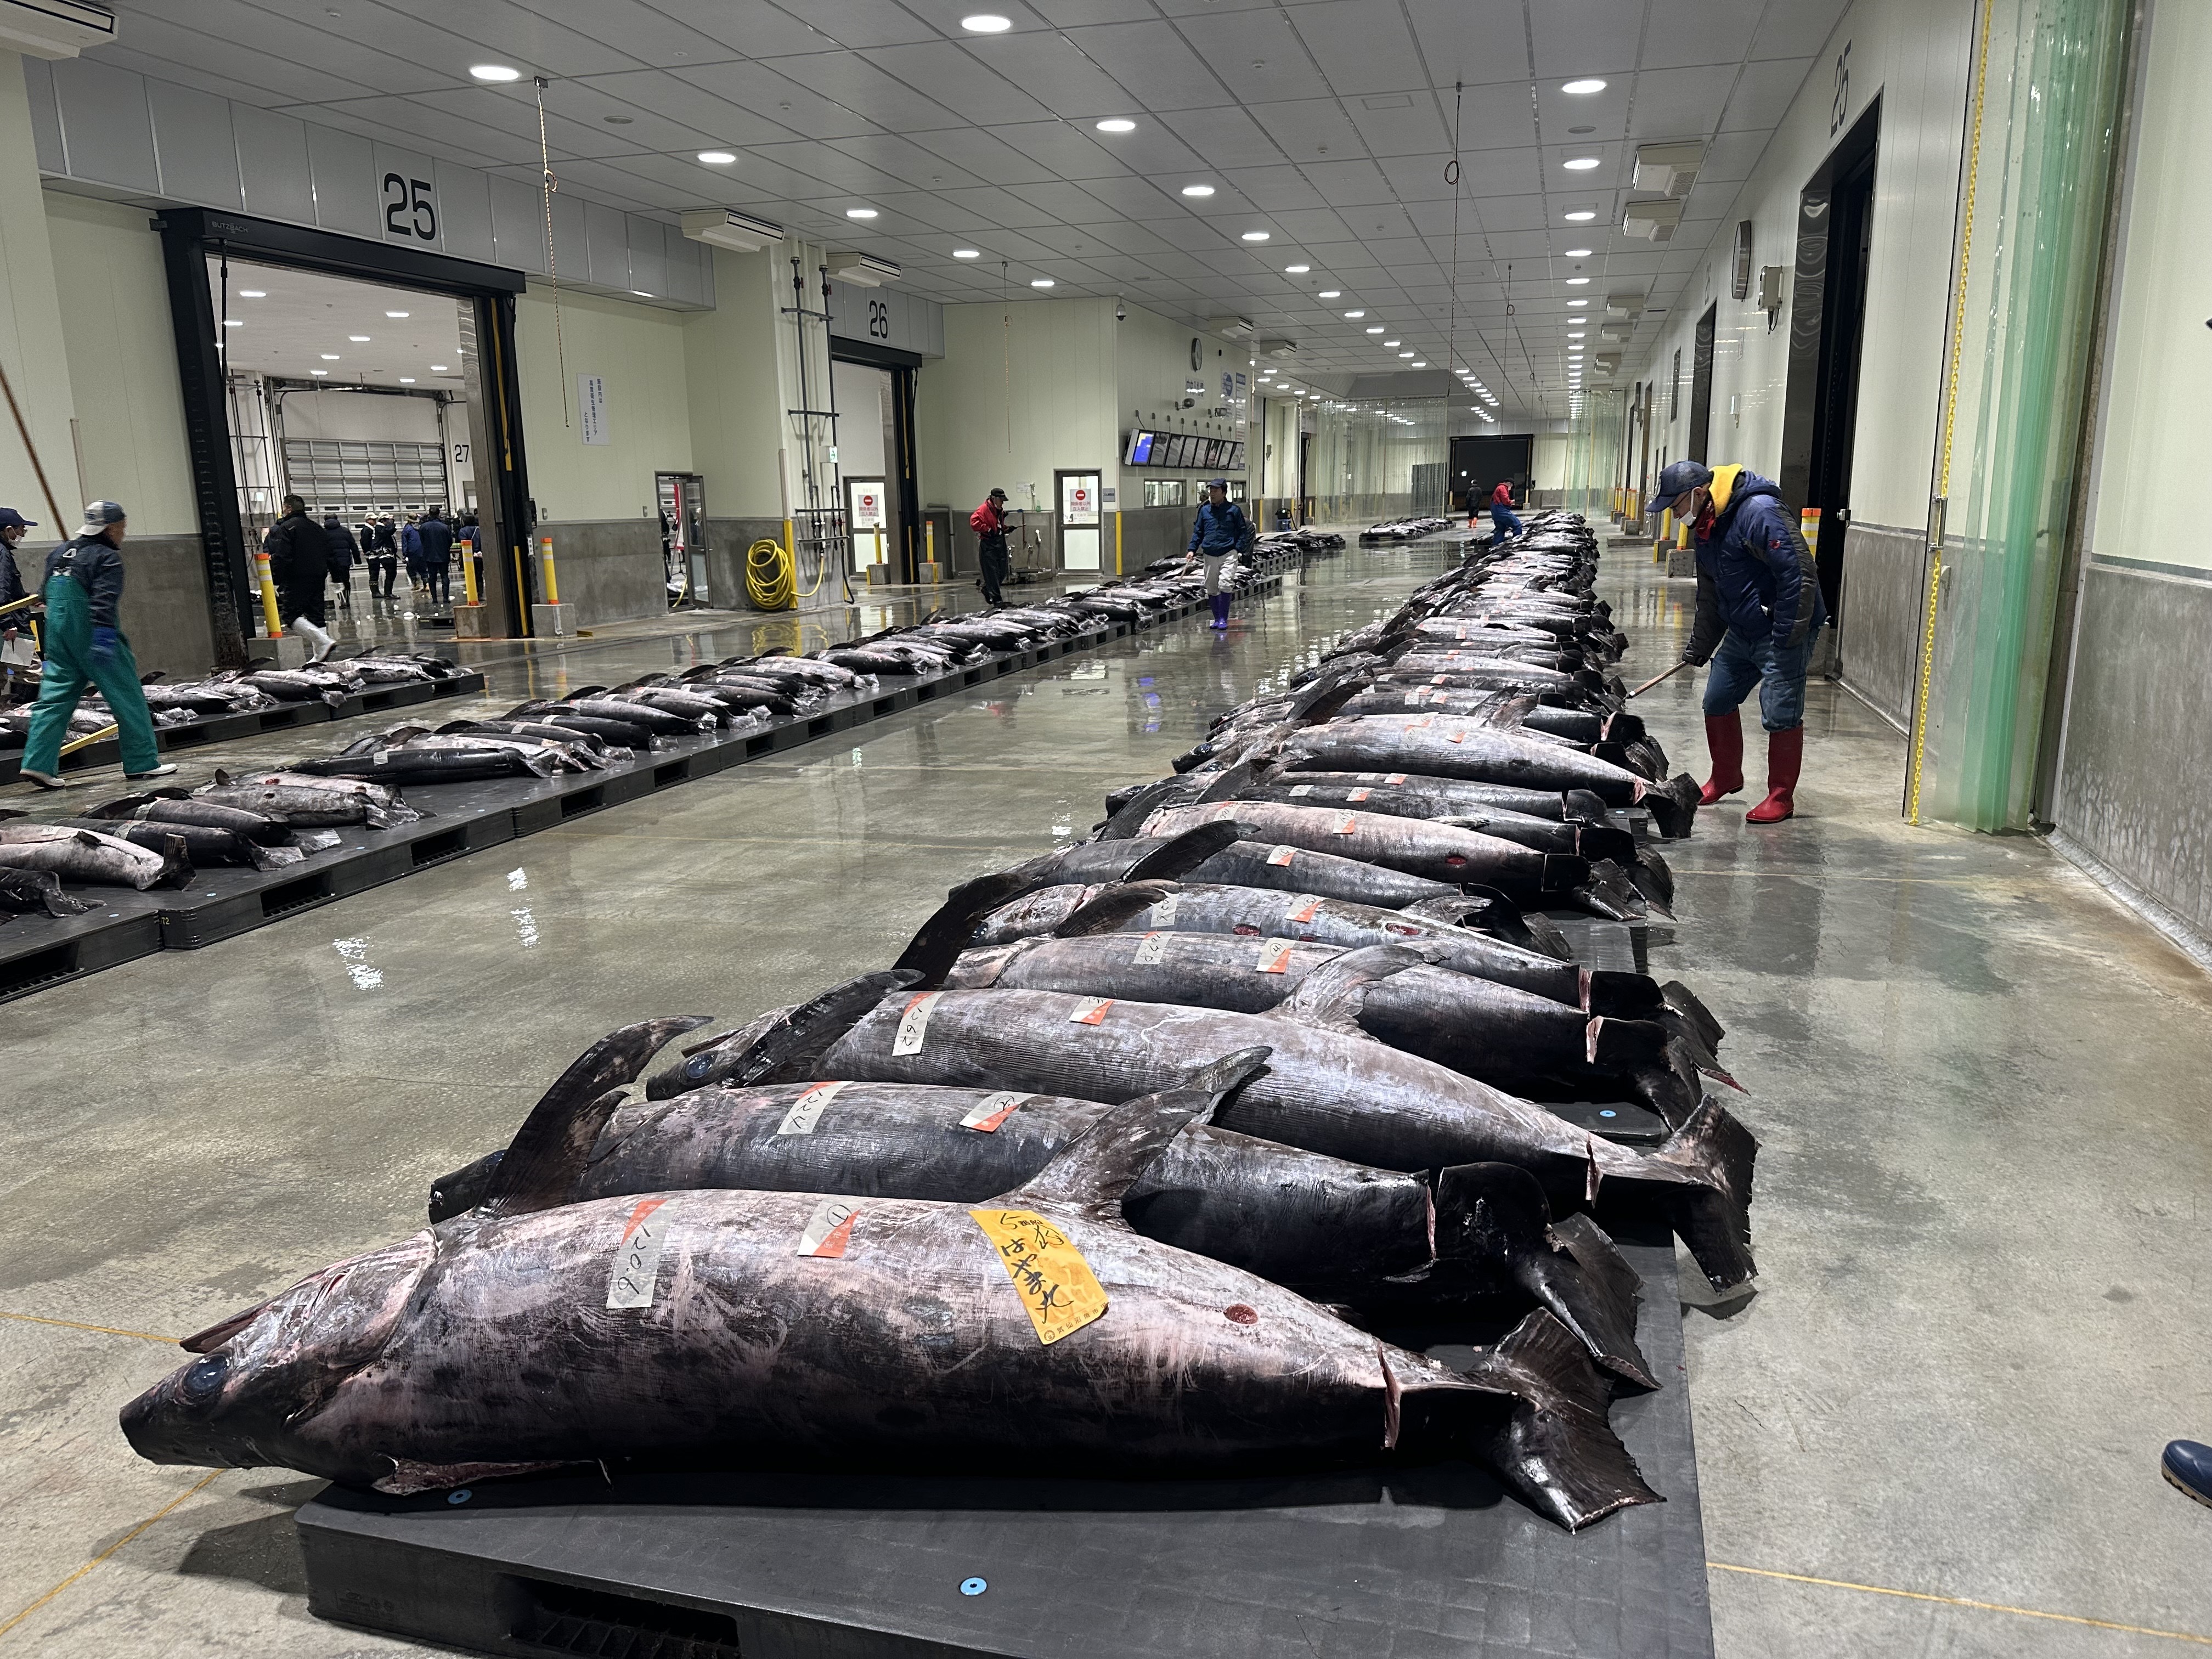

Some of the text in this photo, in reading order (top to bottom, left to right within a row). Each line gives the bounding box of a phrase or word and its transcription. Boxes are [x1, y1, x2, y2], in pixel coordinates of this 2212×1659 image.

[1830, 38, 1852, 139] 25
[384, 173, 436, 240] 25
[869, 300, 888, 338] 26
[454, 444, 469, 462] 27
